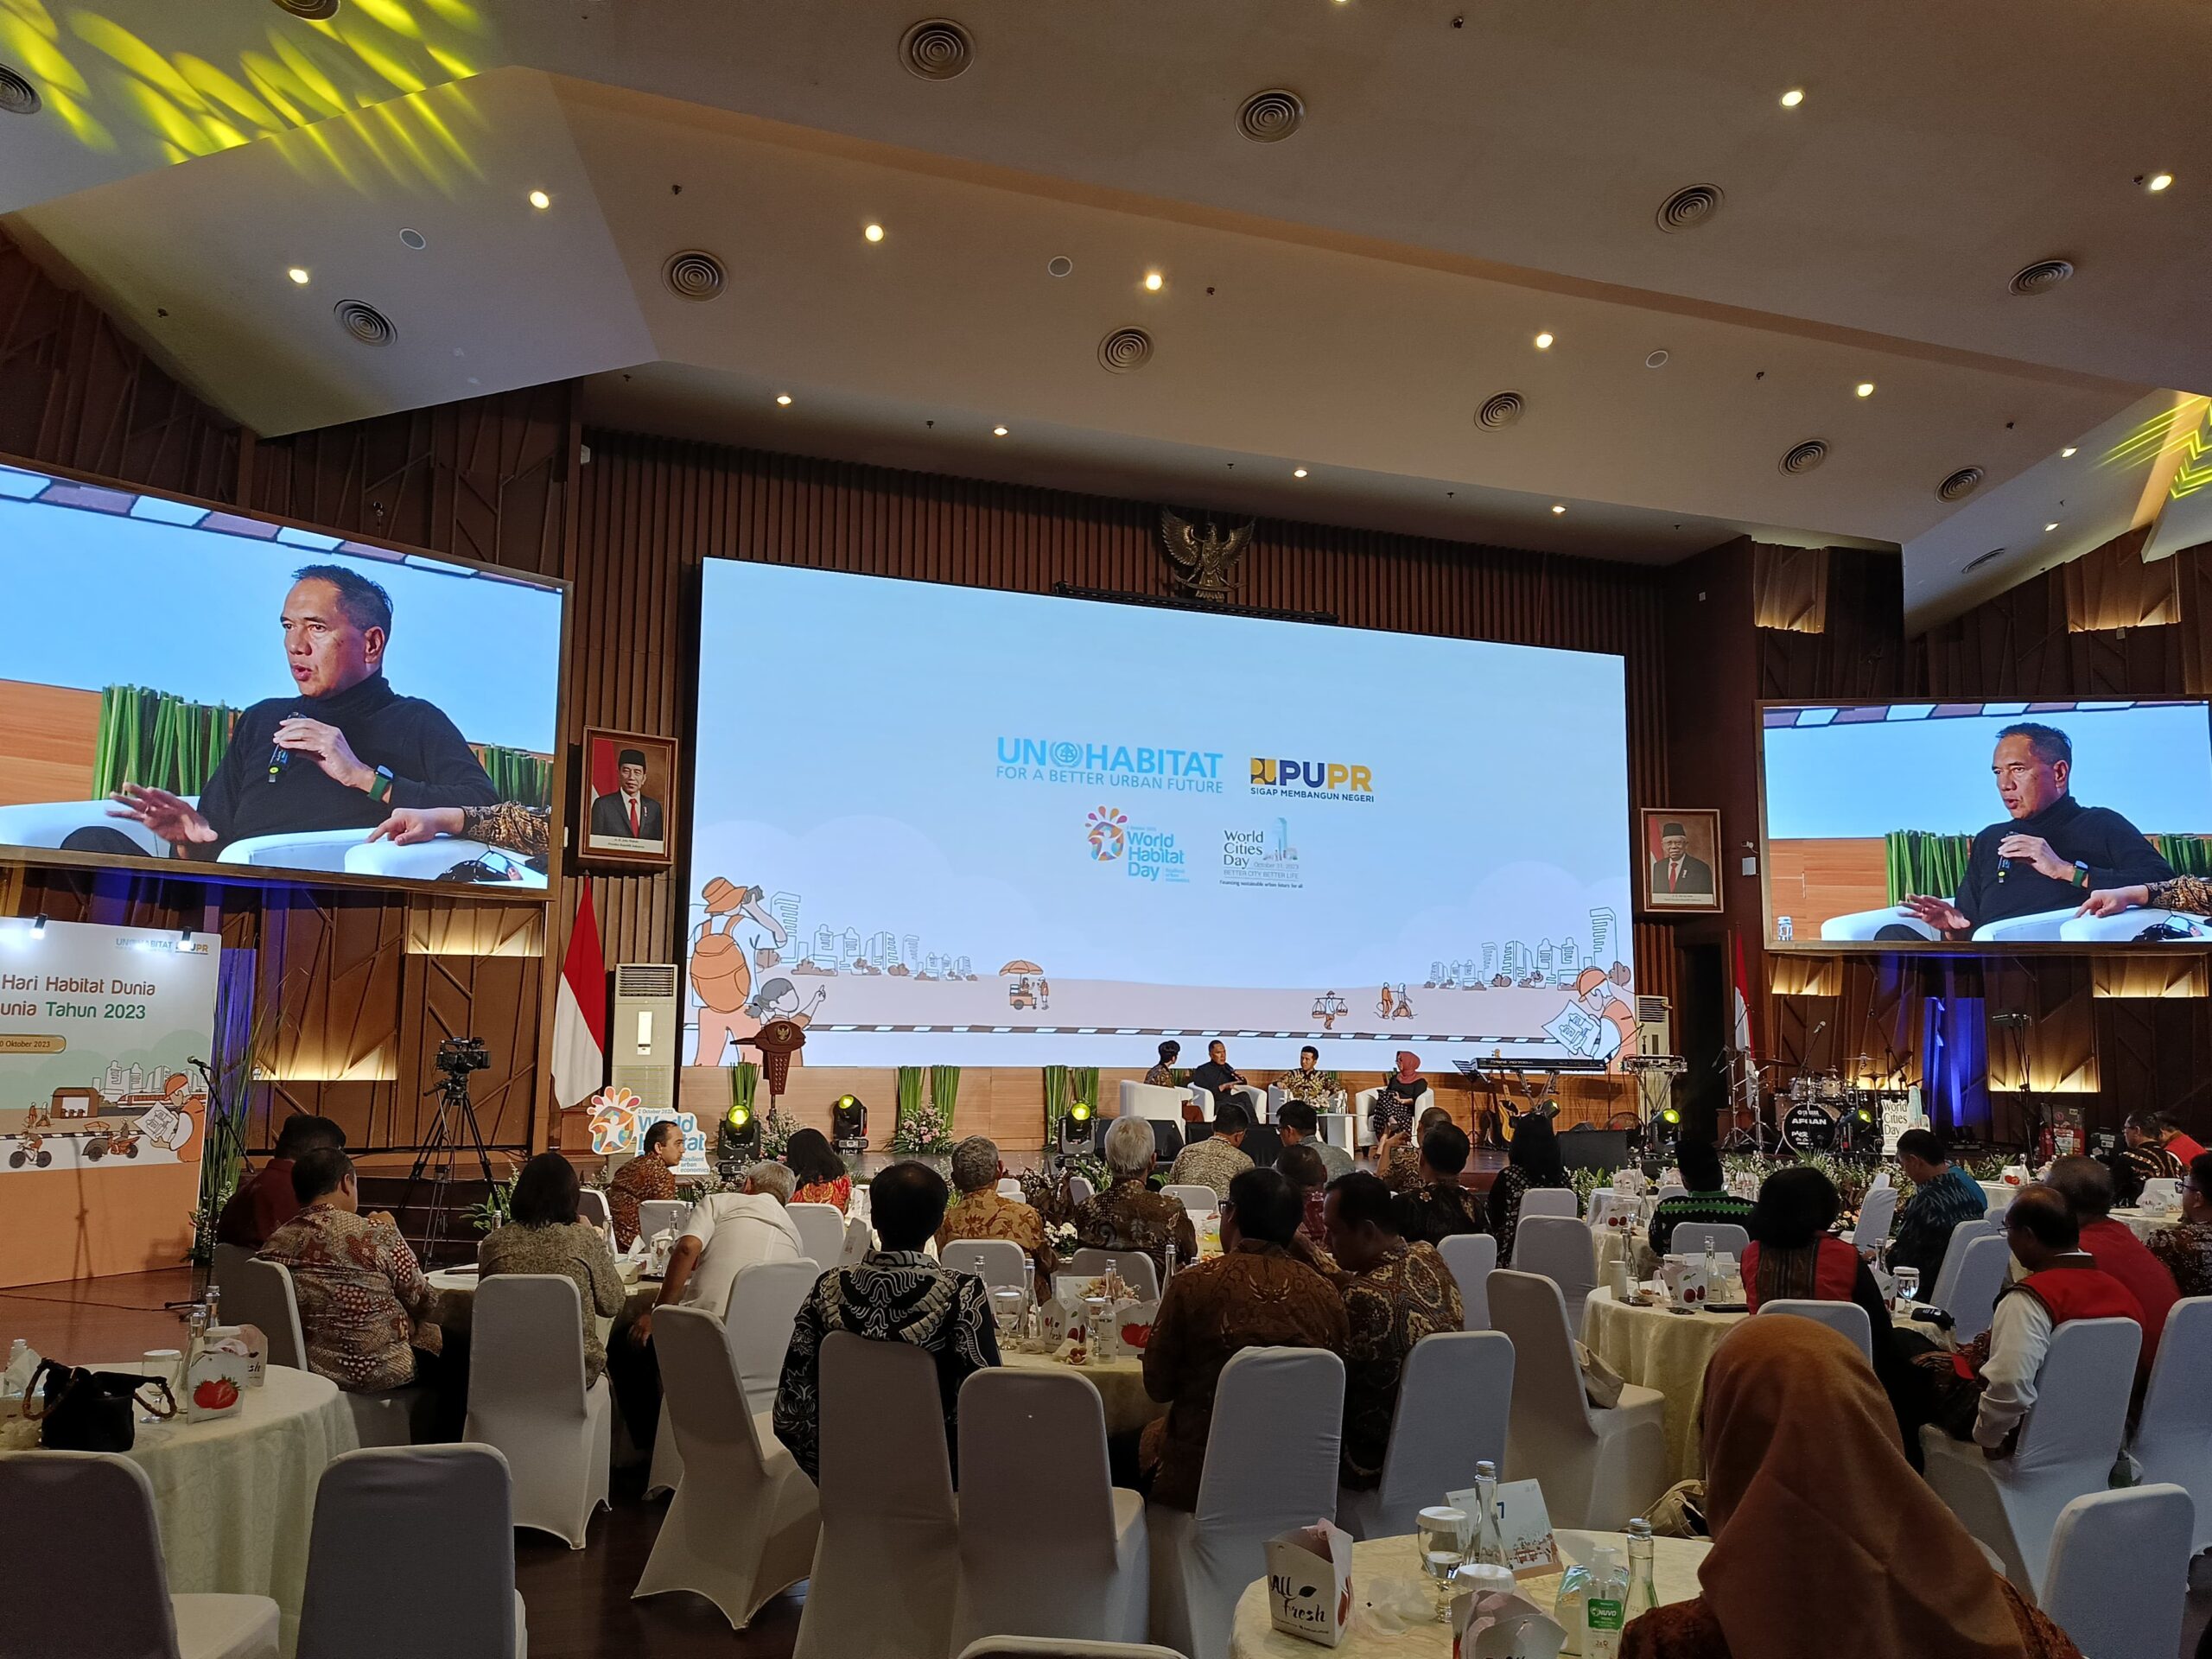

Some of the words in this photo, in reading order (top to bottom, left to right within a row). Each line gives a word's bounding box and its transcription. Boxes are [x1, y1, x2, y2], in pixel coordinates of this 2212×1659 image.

[997, 737, 1046, 766] UN
[1086, 743, 1224, 778] HABITAT
[996, 766, 1027, 779] FOR
[1033, 768, 1044, 781] A
[1049, 770, 1104, 785] BETTER
[1110, 774, 1162, 790] URBAN
[1167, 779, 1224, 794] FUTURE
[1280, 760, 1372, 791] PUPR
[1250, 787, 1278, 796] SIGAP
[1281, 789, 1339, 800] MEMBANGUN
[1342, 793, 1375, 803] NEGERI
[1127, 830, 1174, 848] World
[1224, 830, 1263, 843] World
[1128, 847, 1185, 864] Habitat
[1224, 842, 1262, 855] Cities
[1224, 854, 1249, 869] Day
[1128, 861, 1160, 881] Day
[2, 974, 39, 991] Hari
[45, 976, 105, 994] Habitat
[111, 980, 156, 996] Dunia
[46, 1001, 97, 1018] Tahun
[104, 1004, 146, 1020] 2023
[1883, 1101, 1908, 1113] World
[638, 1116, 694, 1133] Wld
[1884, 1114, 1908, 1124] Cities
[1884, 1124, 1901, 1137] Day
